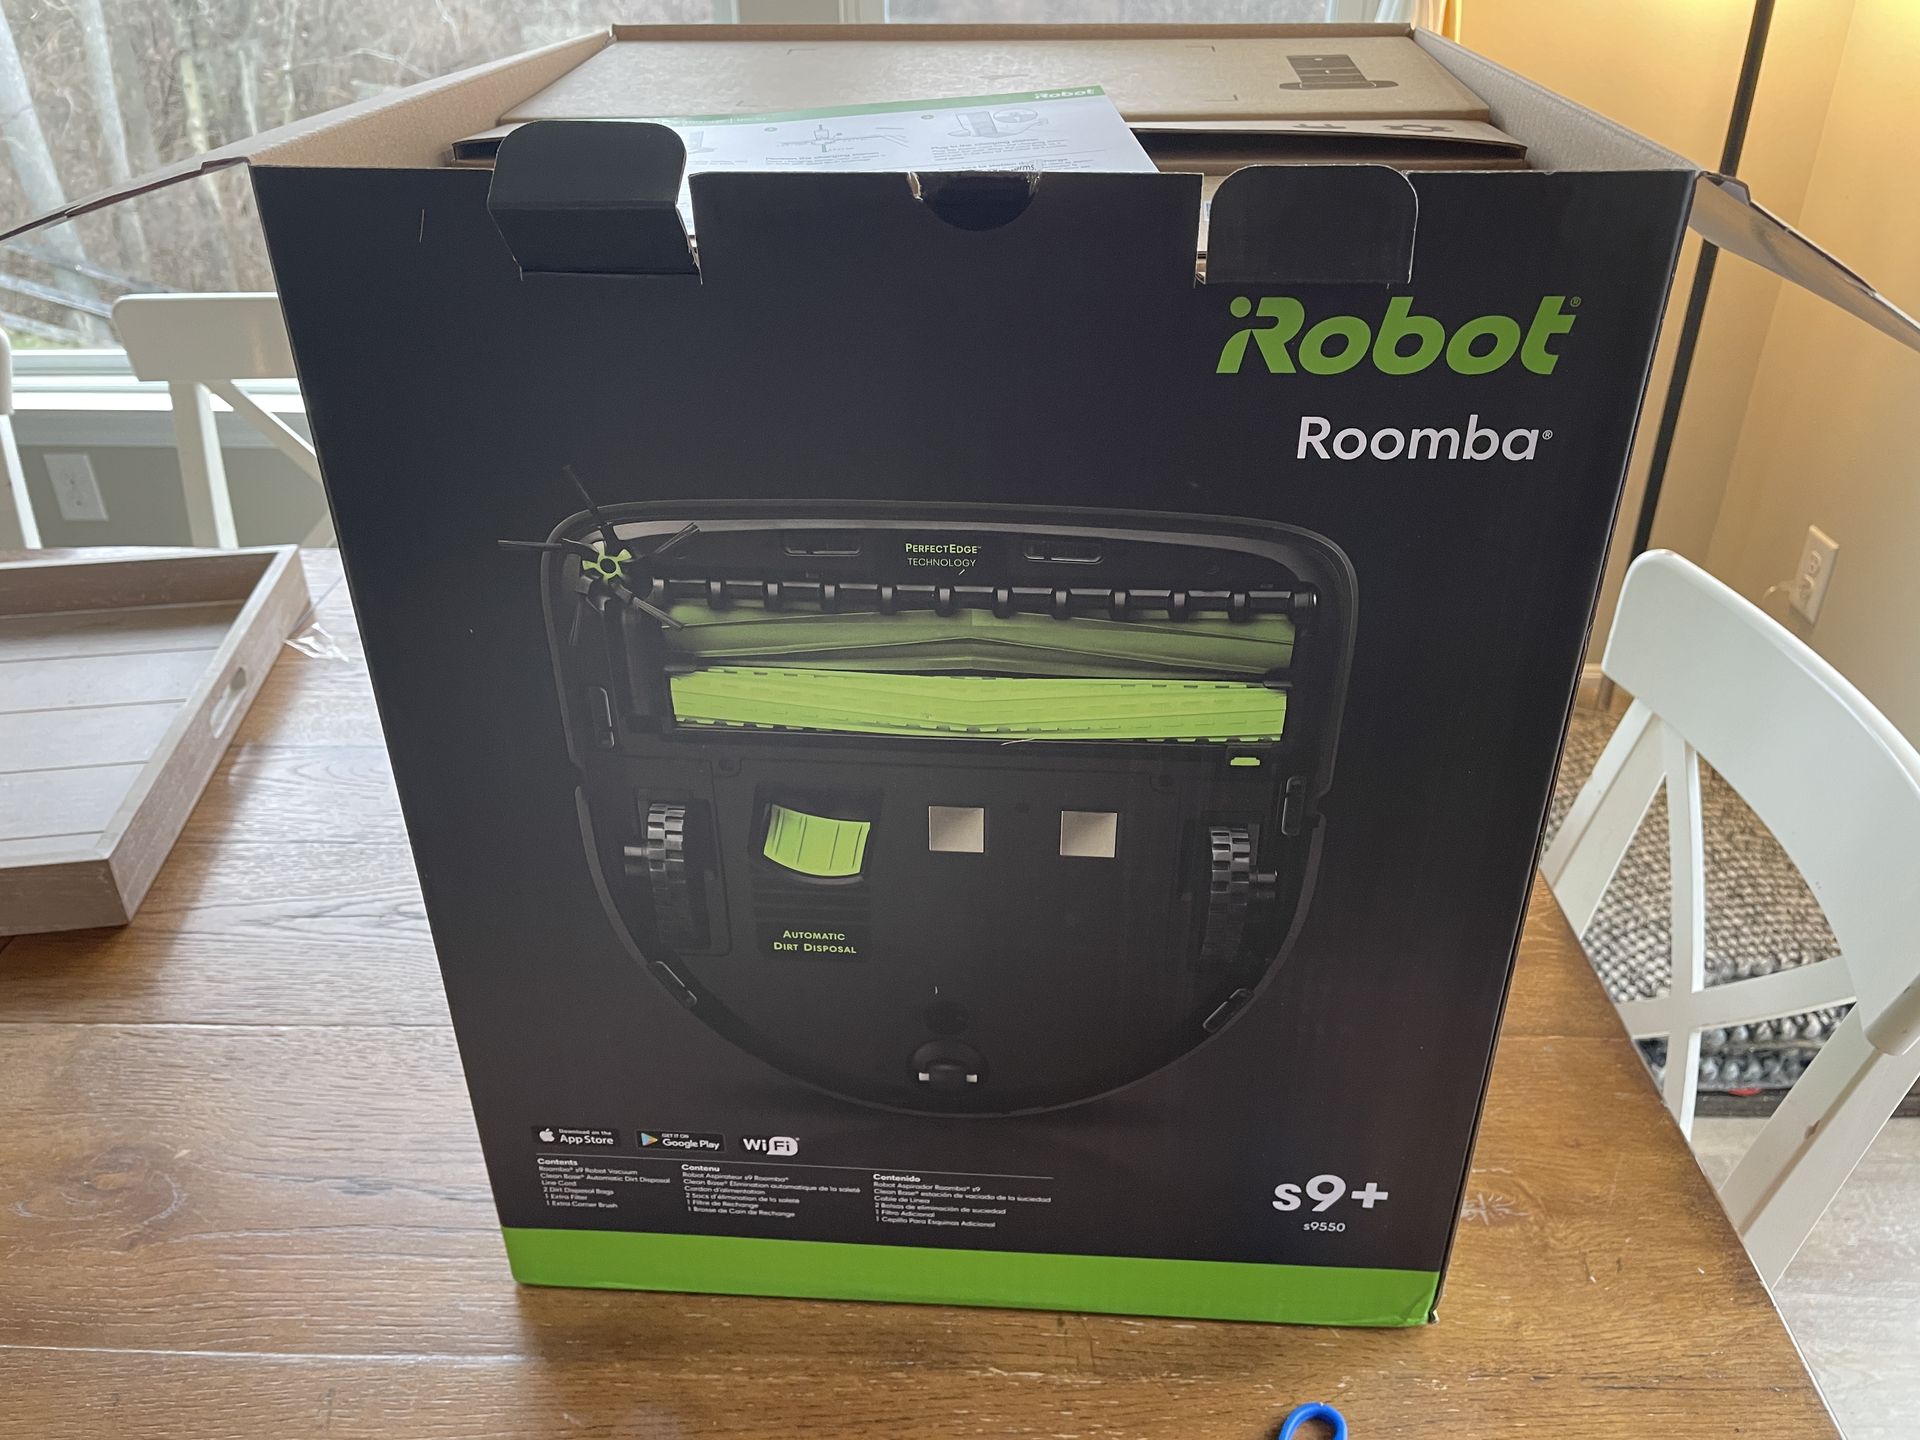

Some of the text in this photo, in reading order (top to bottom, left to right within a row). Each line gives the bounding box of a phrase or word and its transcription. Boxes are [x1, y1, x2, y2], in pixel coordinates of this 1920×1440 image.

[907, 557, 977, 567] TECHNOLOGY
[662, 1138, 720, 1150] Google Play
[536, 1158, 578, 1166] Contents
[681, 1163, 720, 1172] Contenu
[872, 1173, 921, 1183] Contenido
[1272, 1174, 1389, 1212] s9+
[1303, 1221, 1346, 1232] s9550
